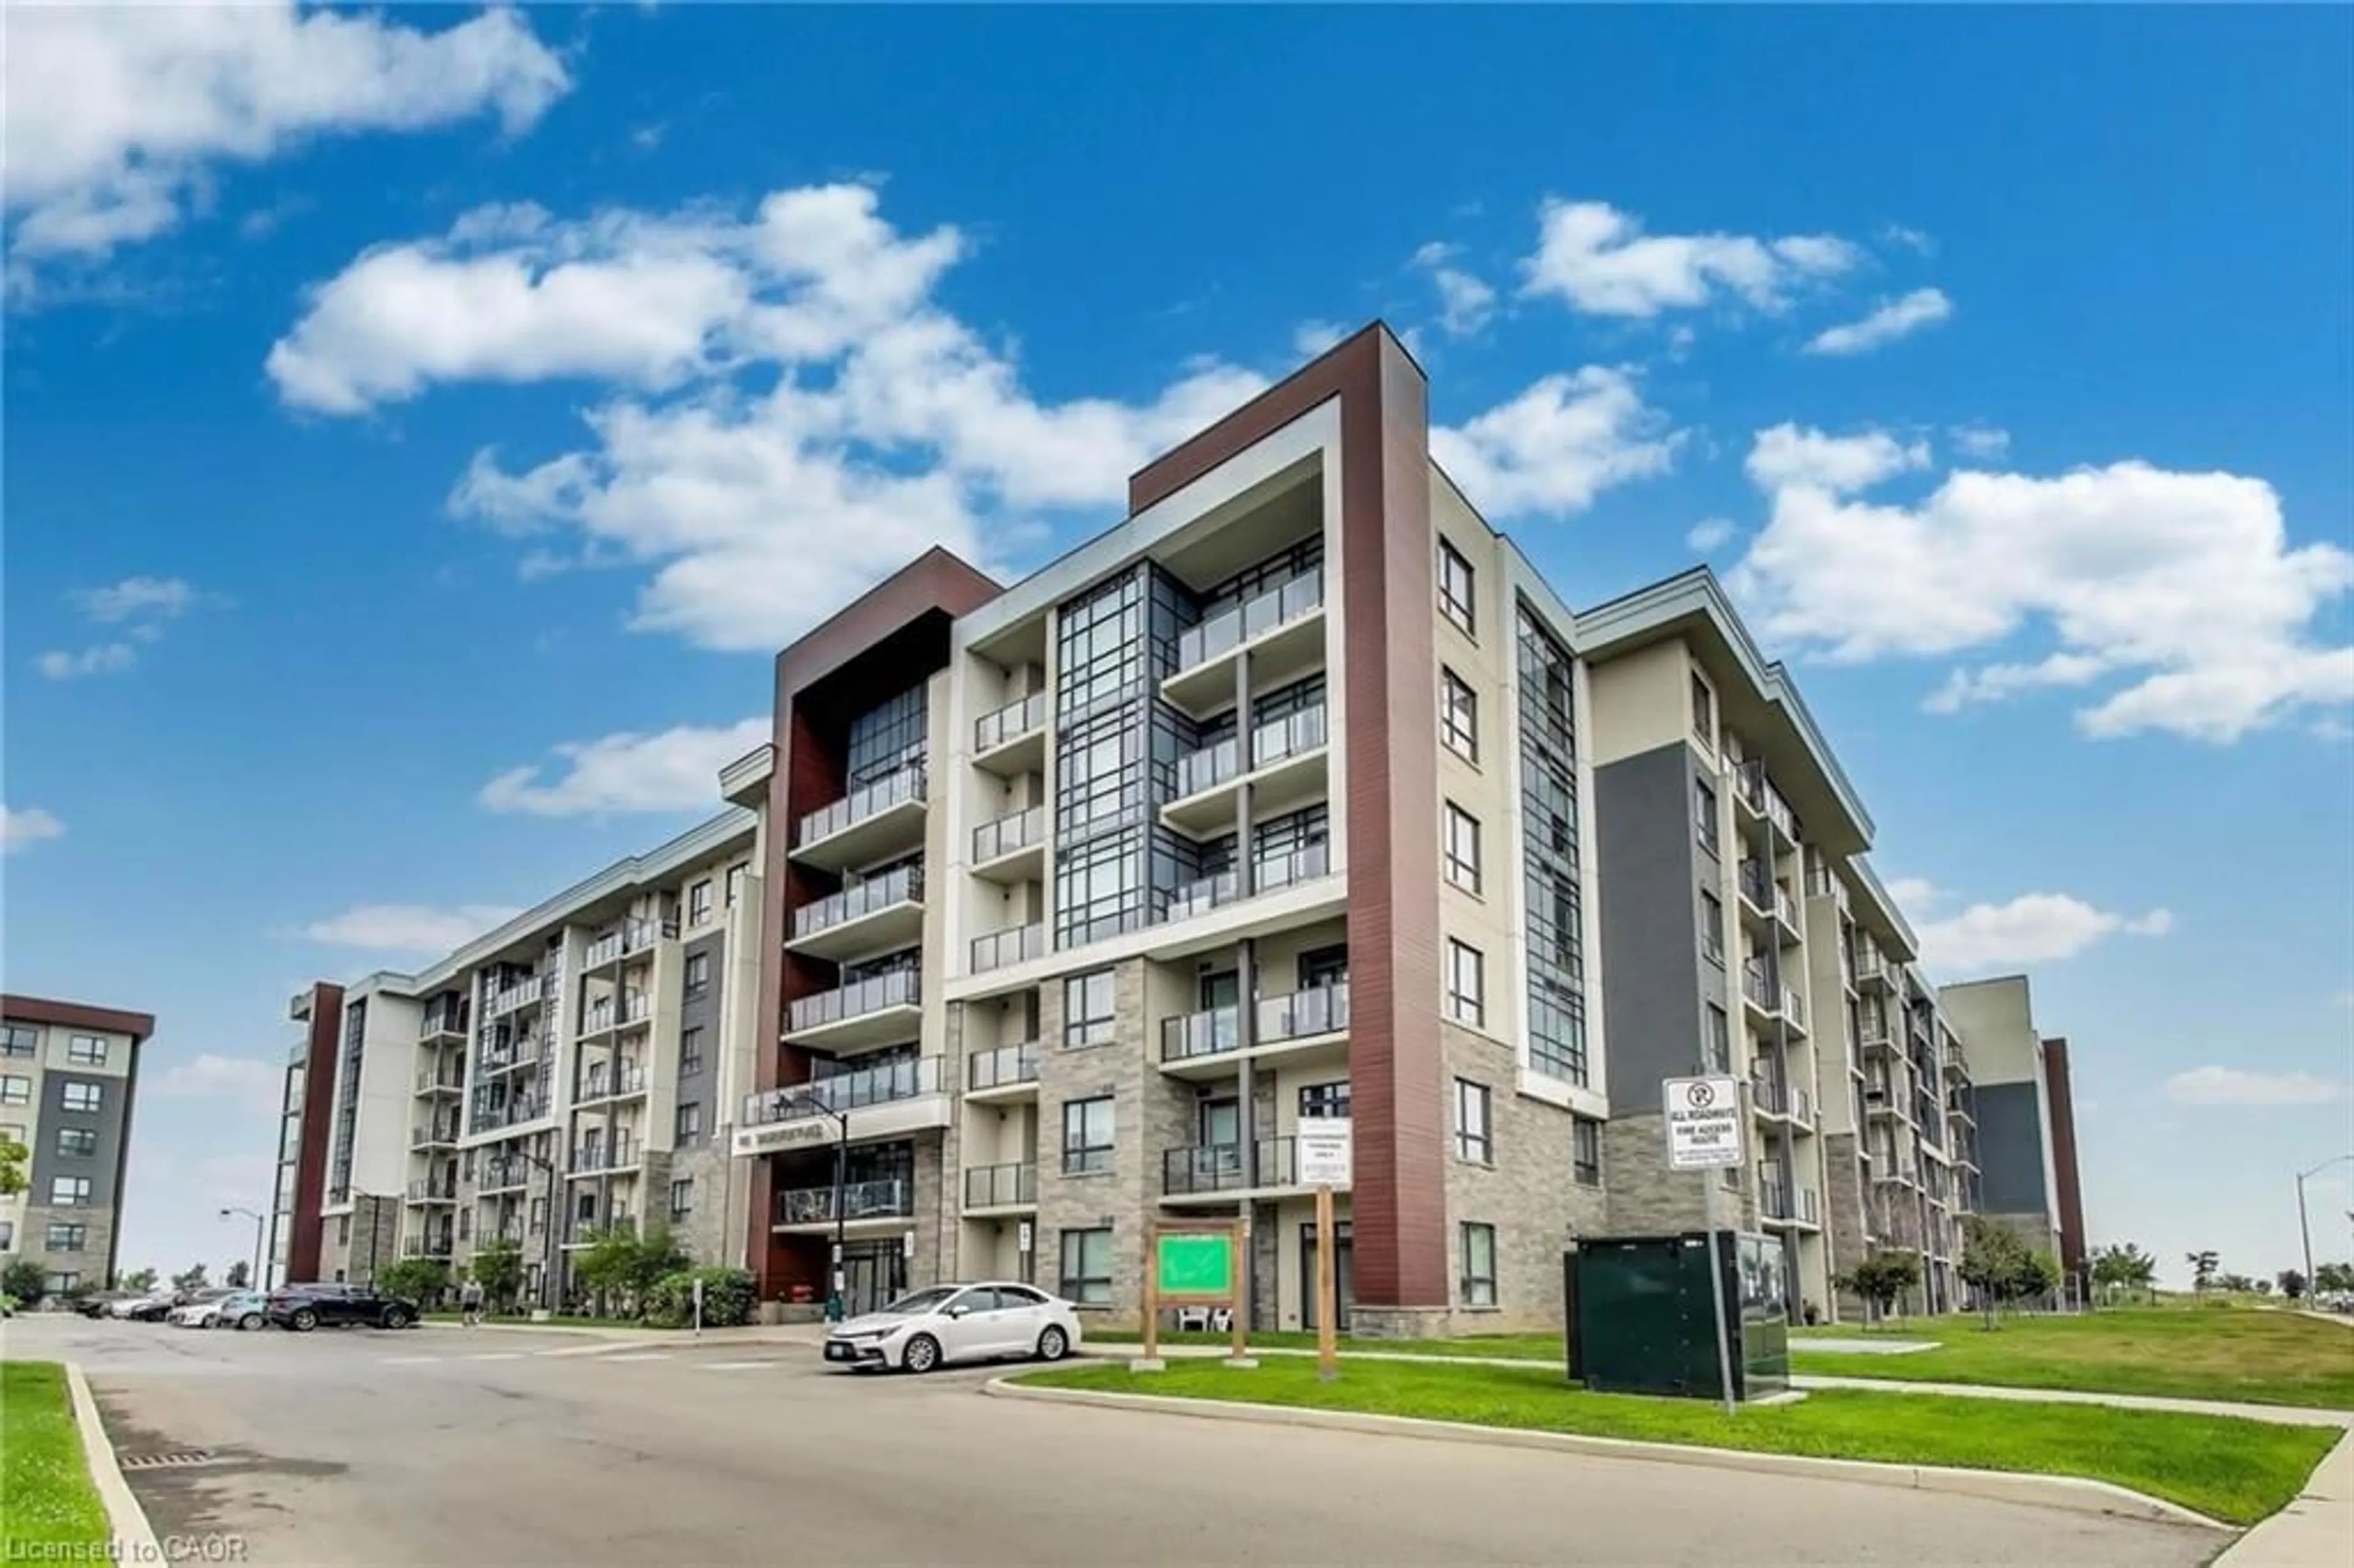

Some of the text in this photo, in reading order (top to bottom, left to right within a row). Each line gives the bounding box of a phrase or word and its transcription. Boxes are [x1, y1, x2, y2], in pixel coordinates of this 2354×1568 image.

[1676, 1123, 1732, 1135] FIRE ACCESS
[1690, 1135, 1720, 1144] ROUTE
